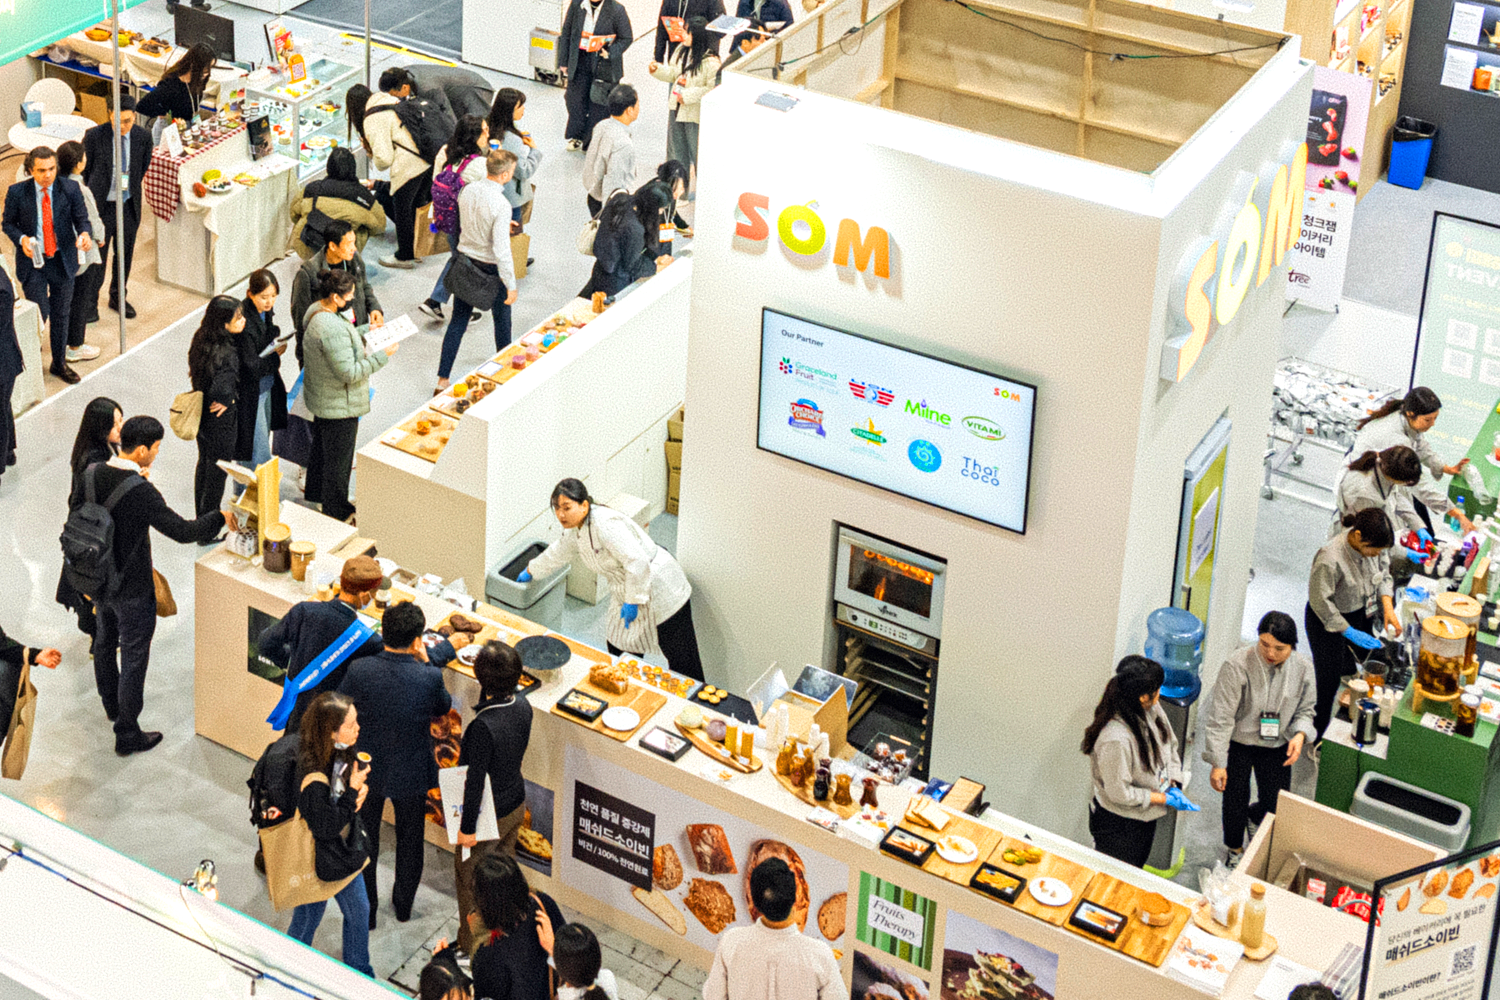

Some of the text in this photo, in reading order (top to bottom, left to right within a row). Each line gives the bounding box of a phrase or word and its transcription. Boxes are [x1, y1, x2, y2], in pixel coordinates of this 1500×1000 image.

[1303, 213, 1337, 233] 청크잼
[735, 191, 890, 280] SOM
[1293, 240, 1326, 260] 아이템
[1177, 142, 1308, 384] SOM
[781, 329, 824, 348] Our Partner
[795, 361, 838, 381] Graceland
[795, 368, 814, 382] Fruit
[993, 387, 1021, 403] SOM
[904, 399, 952, 427] Milne
[580, 798, 651, 839] 천연 품질 증강제
[579, 816, 650, 857] 매쉬드소이빈
[578, 838, 593, 852] 비건
[598, 846, 619, 863] 100%
[873, 899, 905, 921] Fruits
[1463, 903, 1487, 920] 필요한
[874, 911, 917, 941] Therapy
[1385, 924, 1461, 962] 매쉬드소이빈
